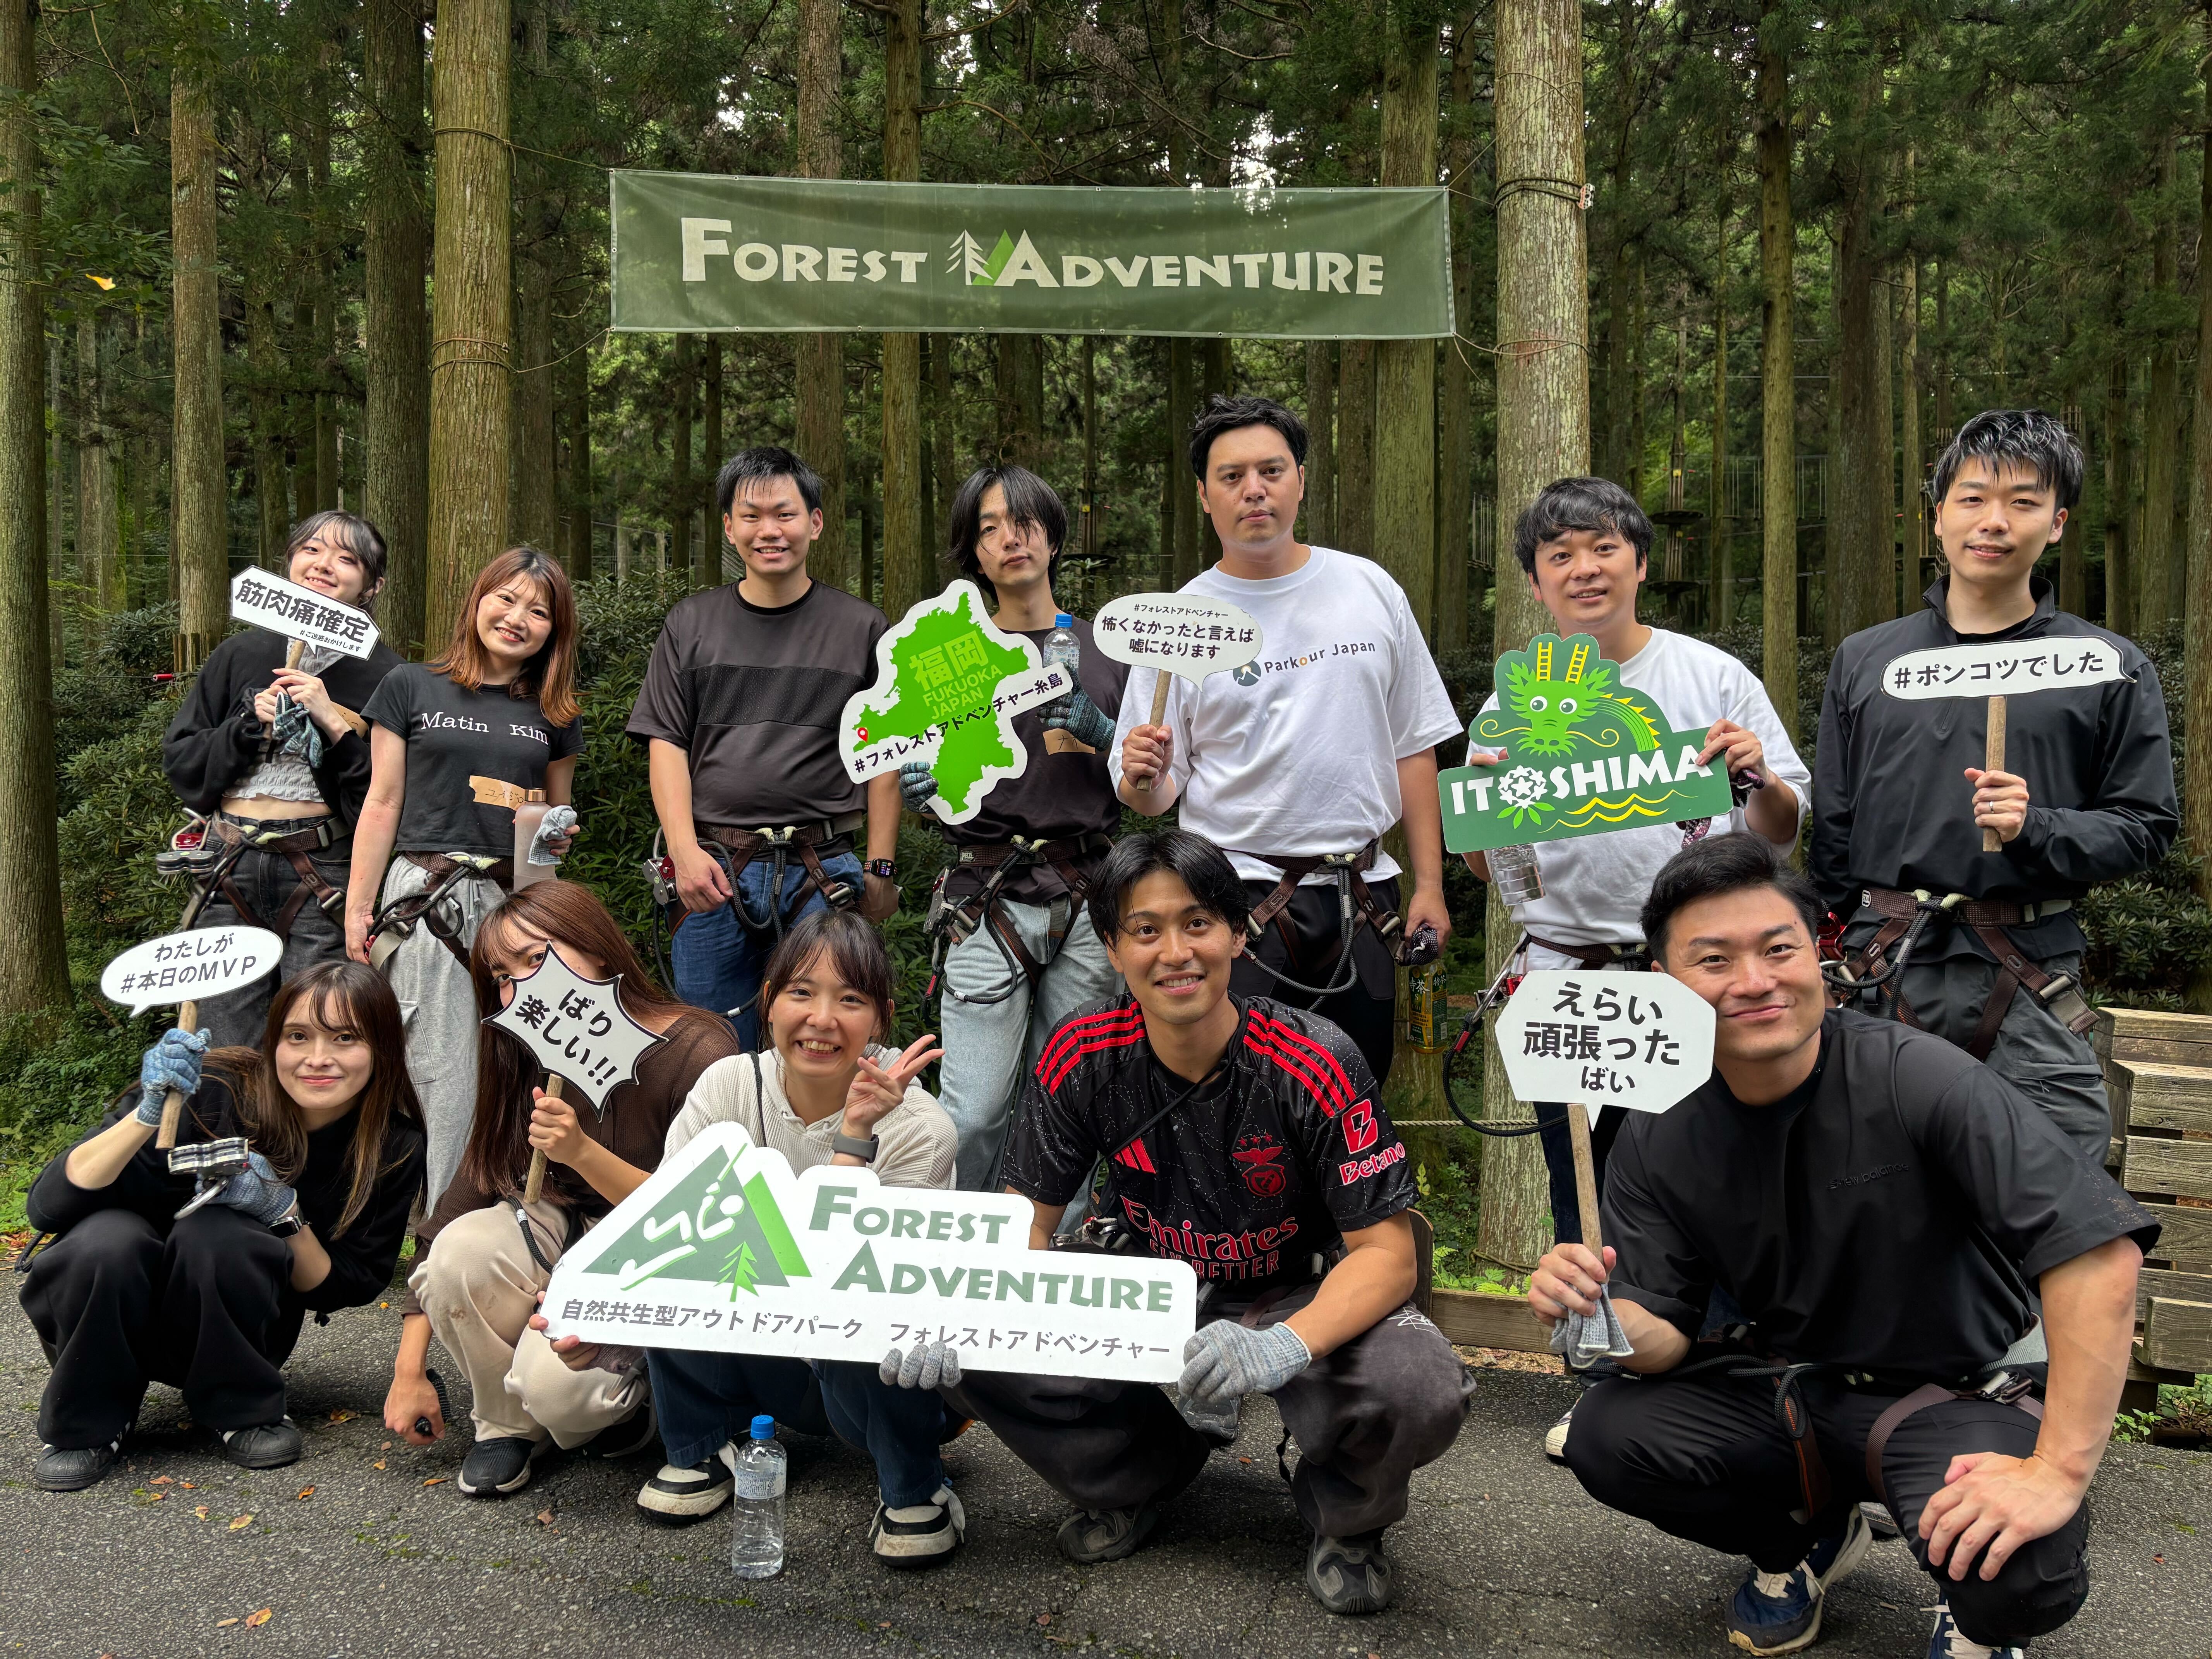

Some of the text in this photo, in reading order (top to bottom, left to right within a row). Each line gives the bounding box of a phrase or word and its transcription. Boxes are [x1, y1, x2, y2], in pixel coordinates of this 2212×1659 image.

[681, 217, 1385, 295] FOREST ADVENTURE
[235, 578, 370, 643] 筋肉痛確定
[1102, 616, 1254, 642] 怖くなかったと言えば
[1134, 604, 1228, 618] #フォレストアドベンチャー
[909, 630, 988, 691] 福岡
[1129, 639, 1221, 659] 嘘になります
[1264, 641, 1376, 674] Parkour Japan
[1894, 652, 2104, 689] #ポンコツでした
[923, 665, 1003, 707] FUKUOKA
[931, 686, 984, 720] JAPAN
[421, 712, 549, 745] Matin Kim
[854, 673, 1063, 773] #フォレストアドベンチャー糸島
[155, 933, 235, 963] わたしが
[120, 956, 256, 994] #本日のMVP
[558, 988, 612, 1037] ばり
[1552, 981, 1663, 1025] えらい
[515, 994, 618, 1086] 楽しい!!
[1523, 1022, 1680, 1066] 頑張った
[1581, 1065, 1635, 1093] ばい
[1339, 1142, 1405, 1186] Betano
[808, 1185, 1012, 1244] FOREST
[1119, 1195, 1299, 1261] Emirates
[831, 1239, 1173, 1313] ADVENTURE
[561, 1298, 1170, 1359] 自然共生型アウトドアパーク フォレストアドベンチャー
